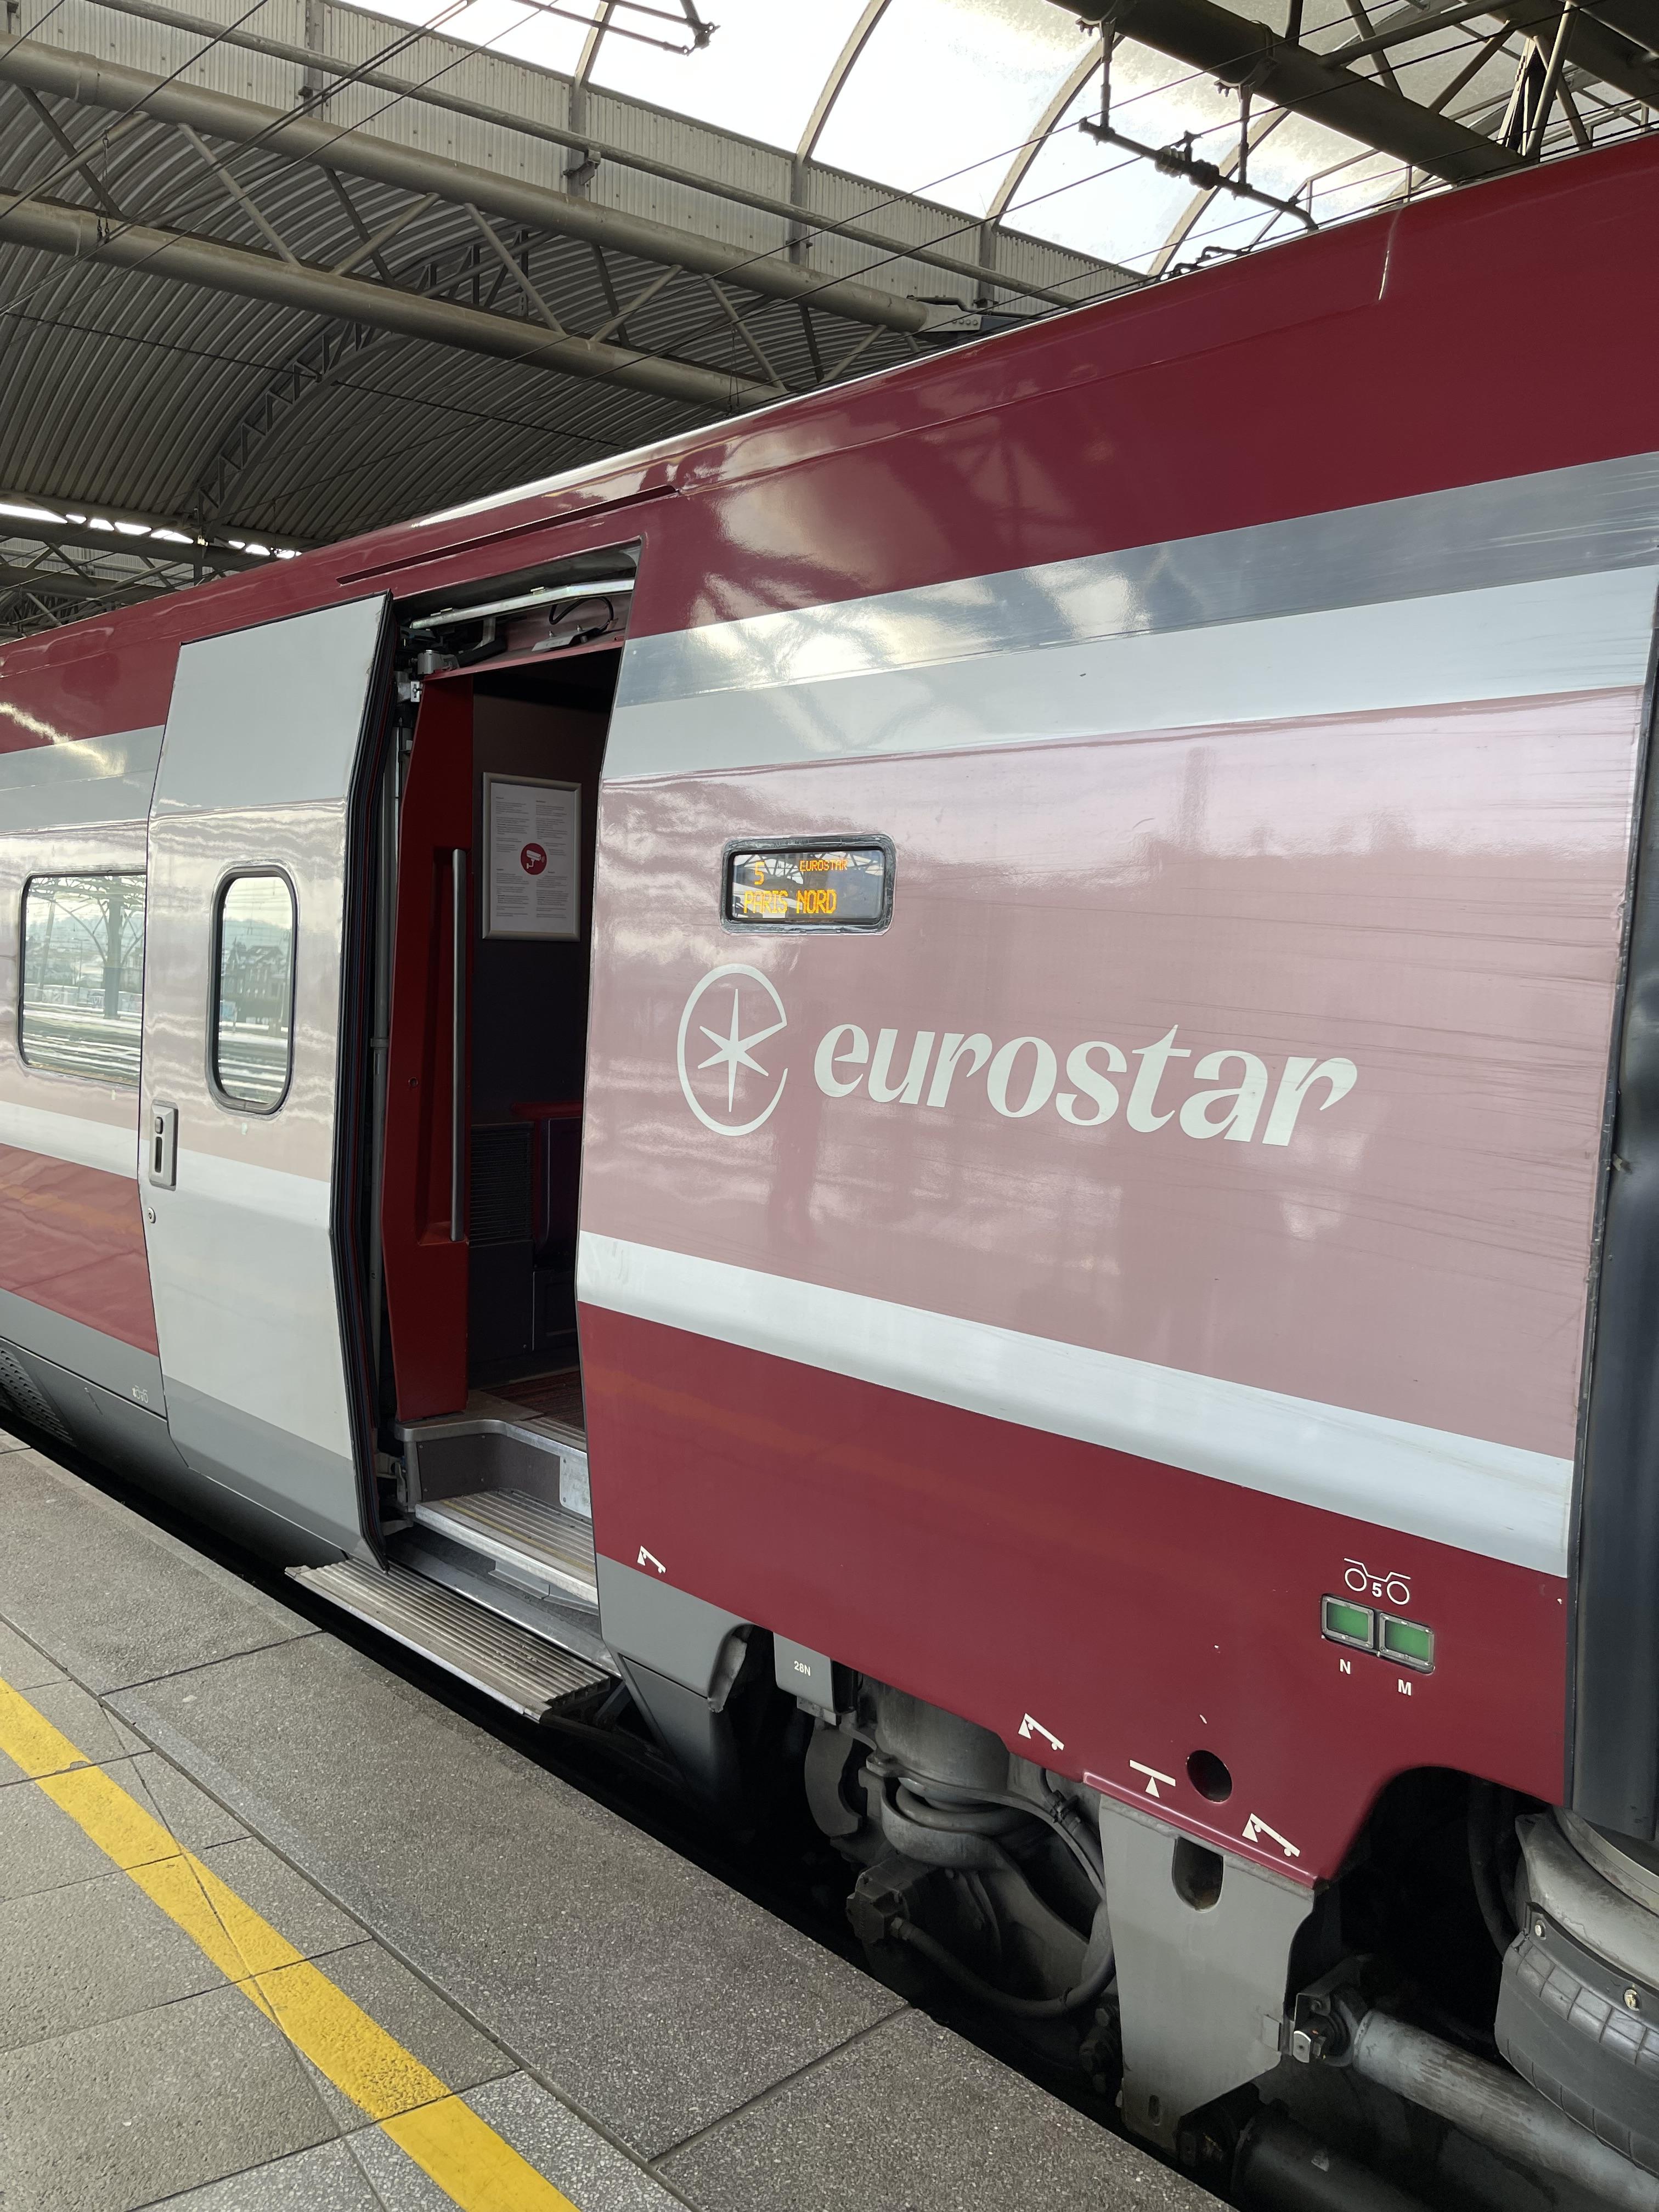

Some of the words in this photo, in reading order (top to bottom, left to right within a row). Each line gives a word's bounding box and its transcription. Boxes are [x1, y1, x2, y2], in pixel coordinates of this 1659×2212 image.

[754, 861, 765, 885] 5
[799, 859, 849, 872] EUROSTAR
[743, 889, 789, 913] PARIS
[795, 889, 838, 913] NORD
[814, 1024, 1358, 1147] eurostar
[1372, 1582, 1382, 1597] 5
[794, 1660, 811, 1677] 28N
[1340, 1659, 1351, 1674] N
[1398, 1679, 1412, 1696] M
